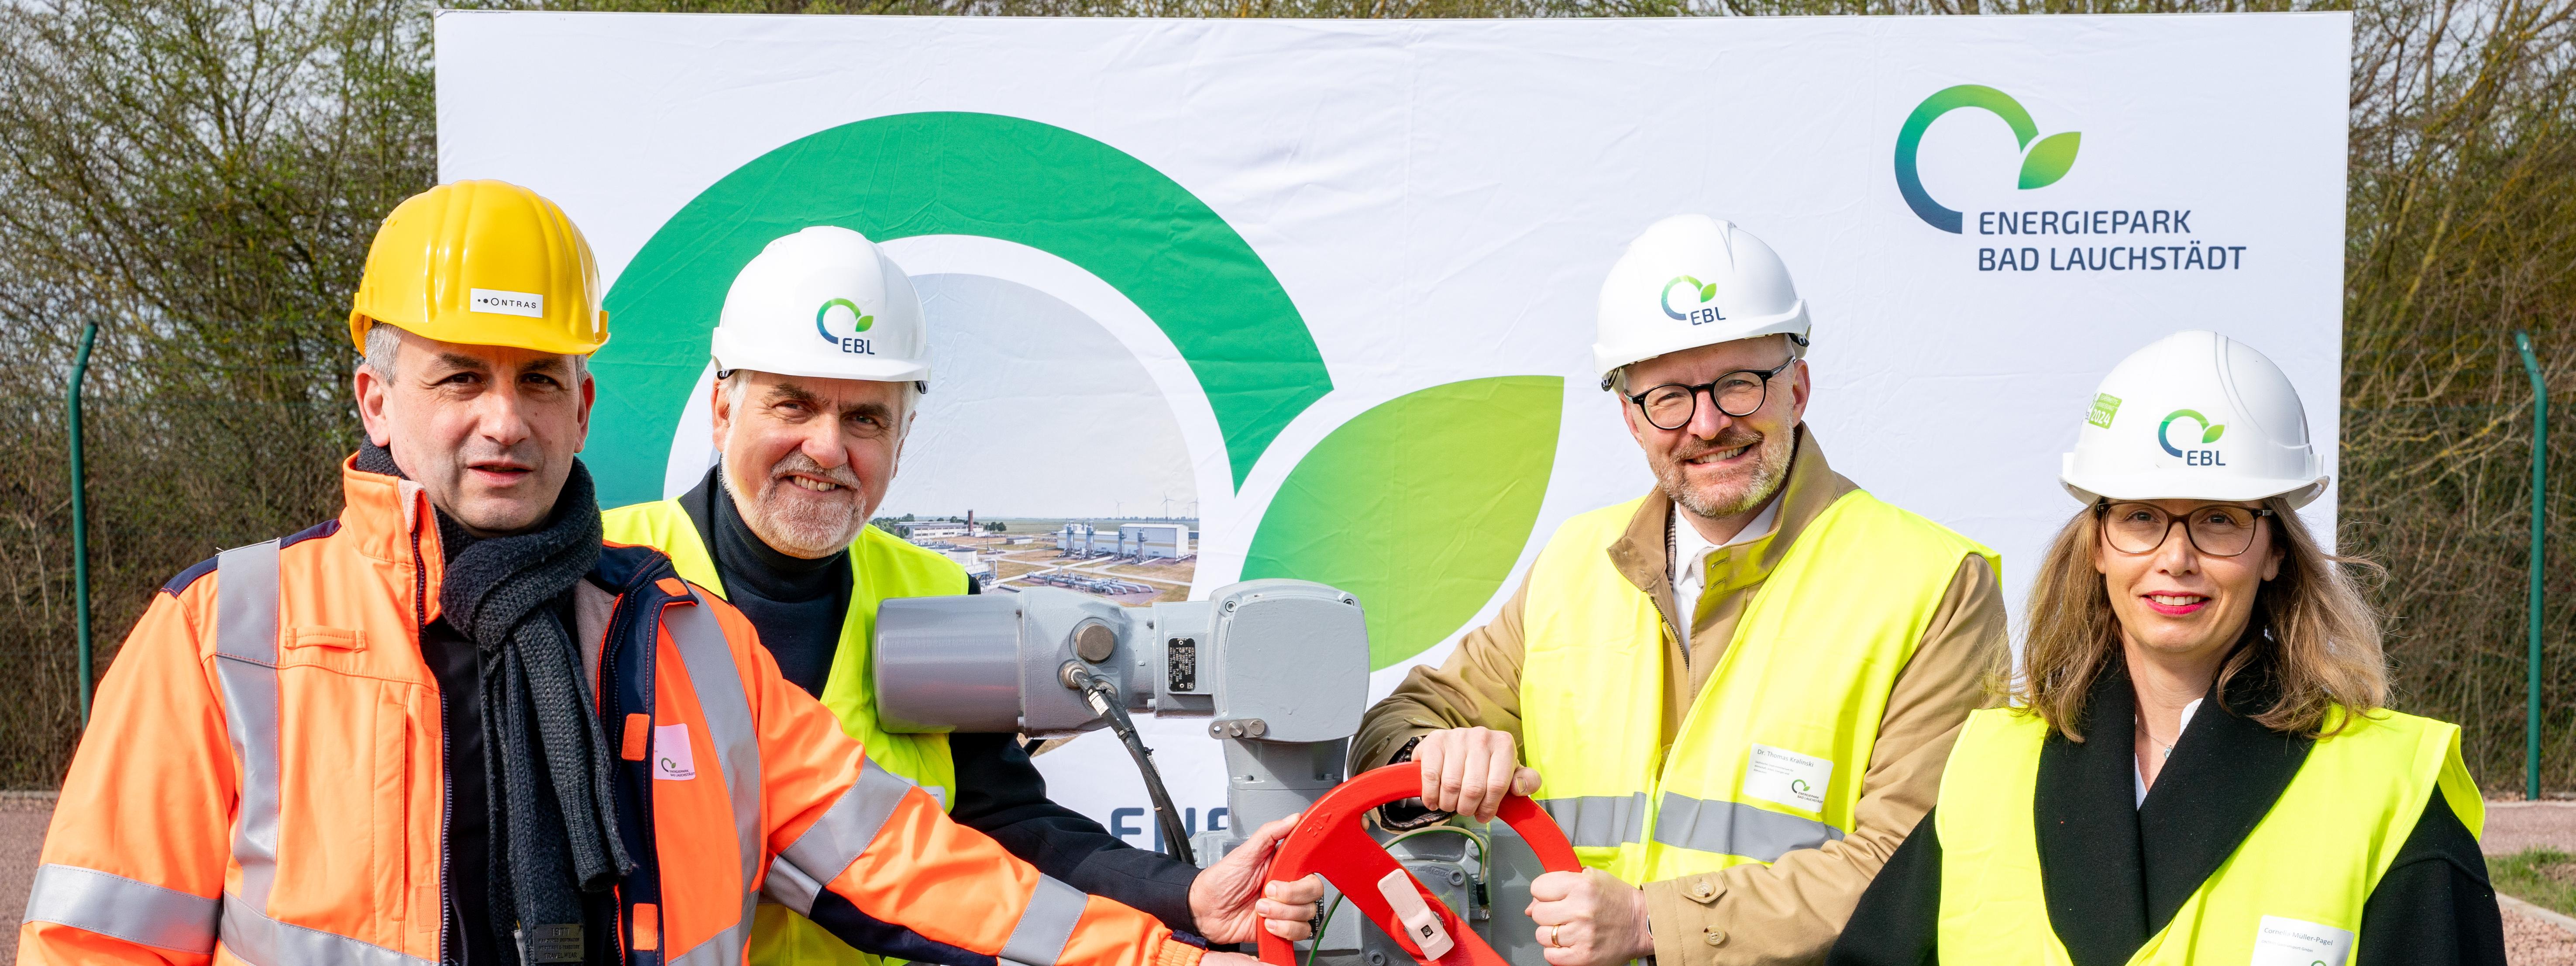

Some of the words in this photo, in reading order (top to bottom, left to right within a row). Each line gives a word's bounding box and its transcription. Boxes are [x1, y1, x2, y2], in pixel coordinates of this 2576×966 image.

[1979, 210, 2191, 235] ENERGIEPARK
[1978, 247, 2039, 271] BAD
[2050, 240, 2247, 271] LAUCHSTÄDT
[491, 298, 536, 309] ONTRAS
[1690, 307, 1726, 326] EBL
[843, 338, 875, 355] EBL
[2090, 408, 2111, 426] 2024
[2187, 450, 2226, 466] EBL
[1767, 751, 1788, 761] Thomas
[1790, 757, 1814, 767] Kralinski
[551, 928, 570, 936] 1977
[2264, 927, 2291, 937] Cornelia
[2292, 932, 2333, 946] Müller-Pagel
